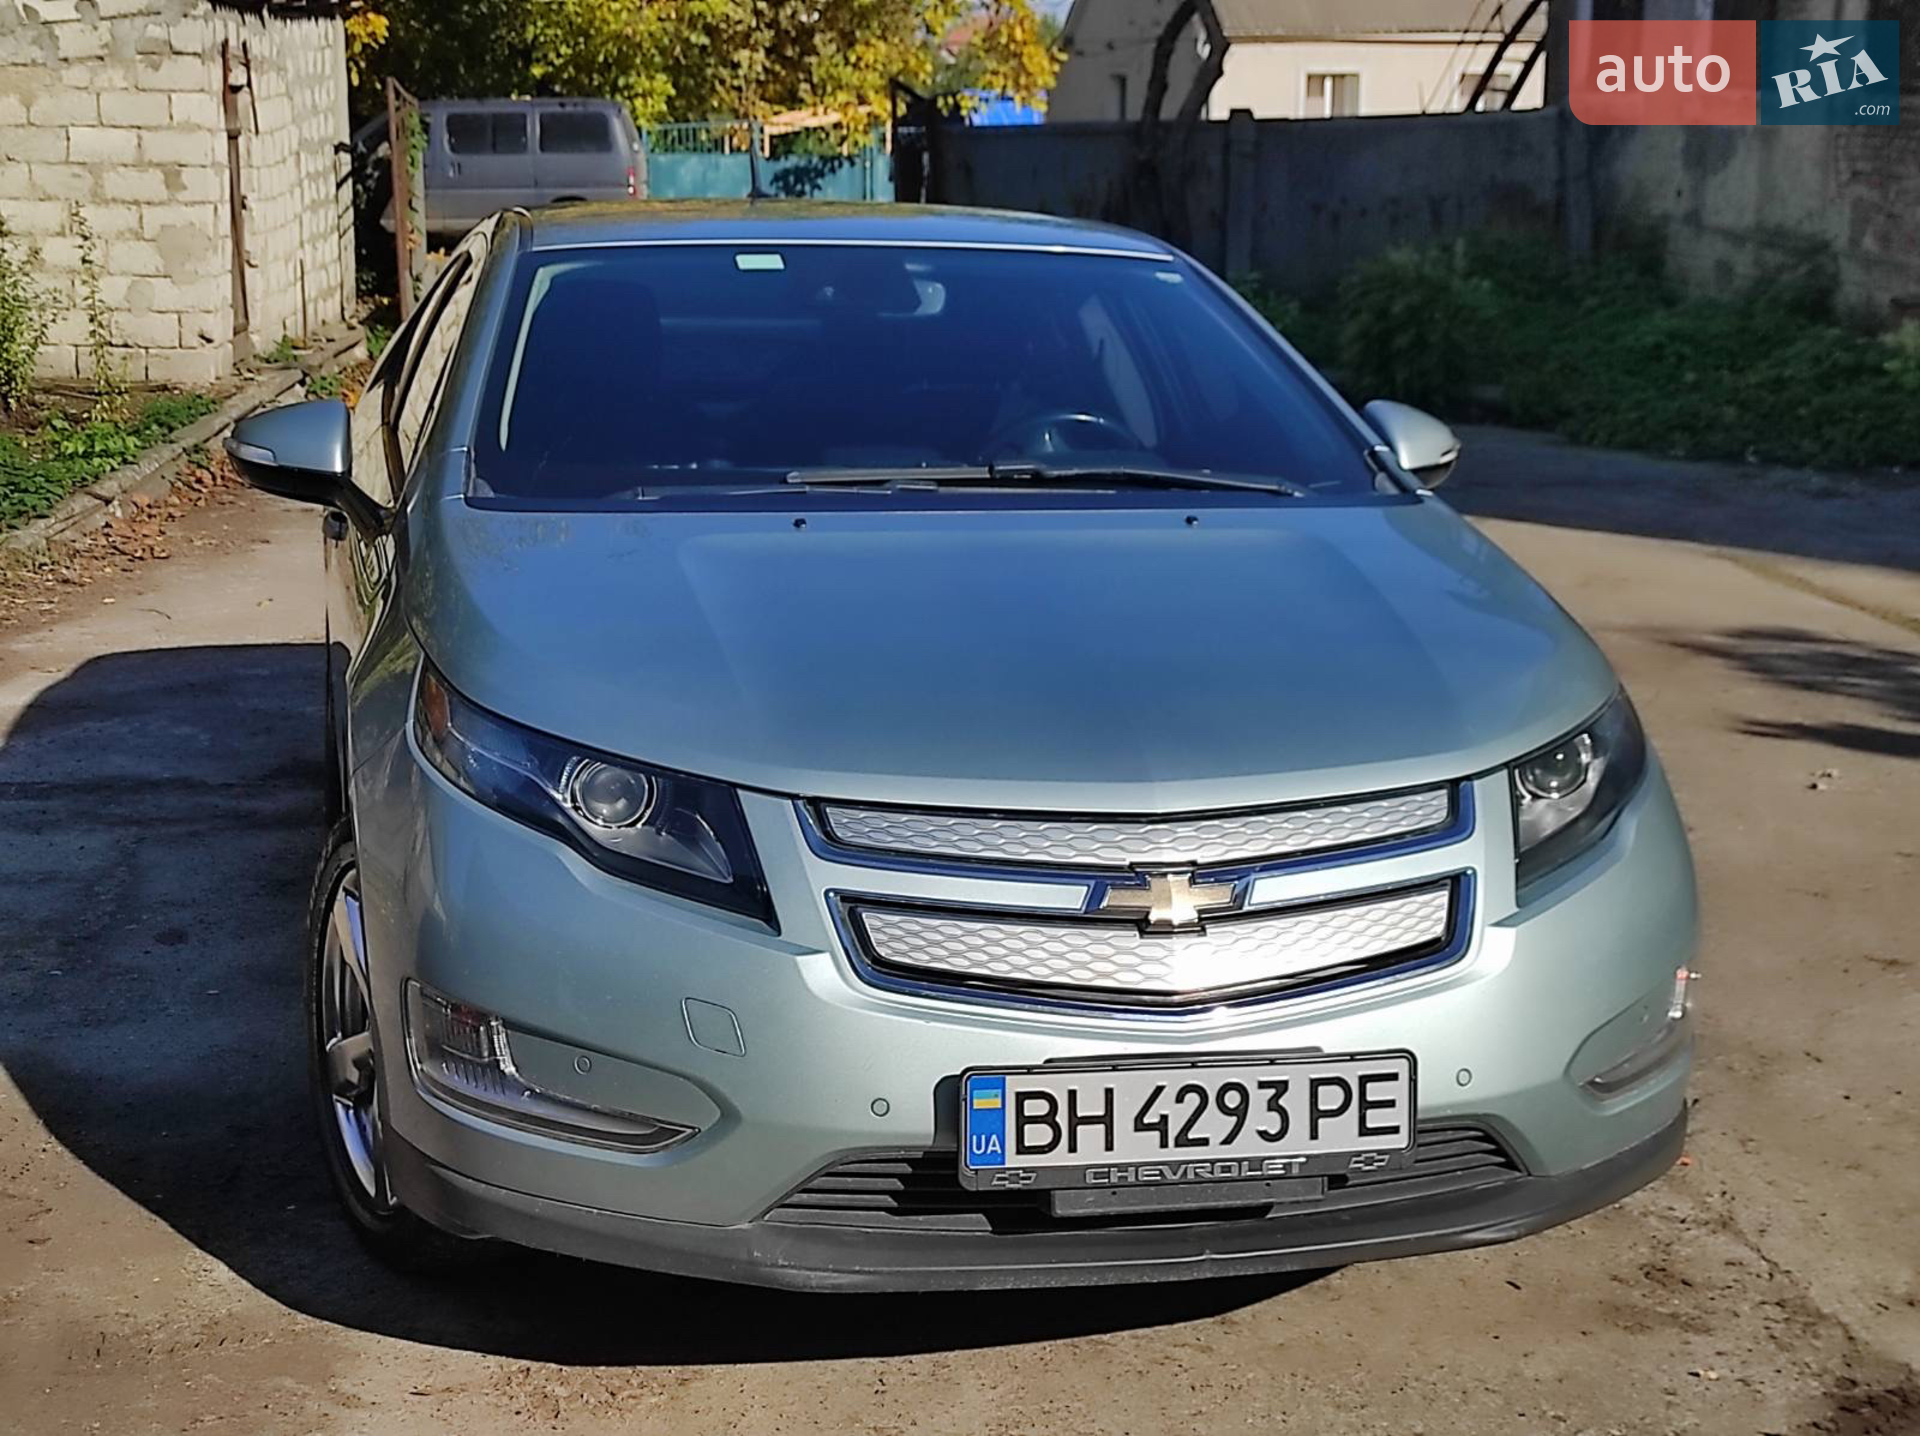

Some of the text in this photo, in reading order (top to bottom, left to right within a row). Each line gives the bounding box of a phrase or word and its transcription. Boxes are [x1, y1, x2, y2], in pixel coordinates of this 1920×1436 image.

[1014, 1072, 1402, 1156] BH 4293 PE
[971, 1134, 1001, 1155] UA
[1085, 1157, 1307, 1185] CHEVROLET
